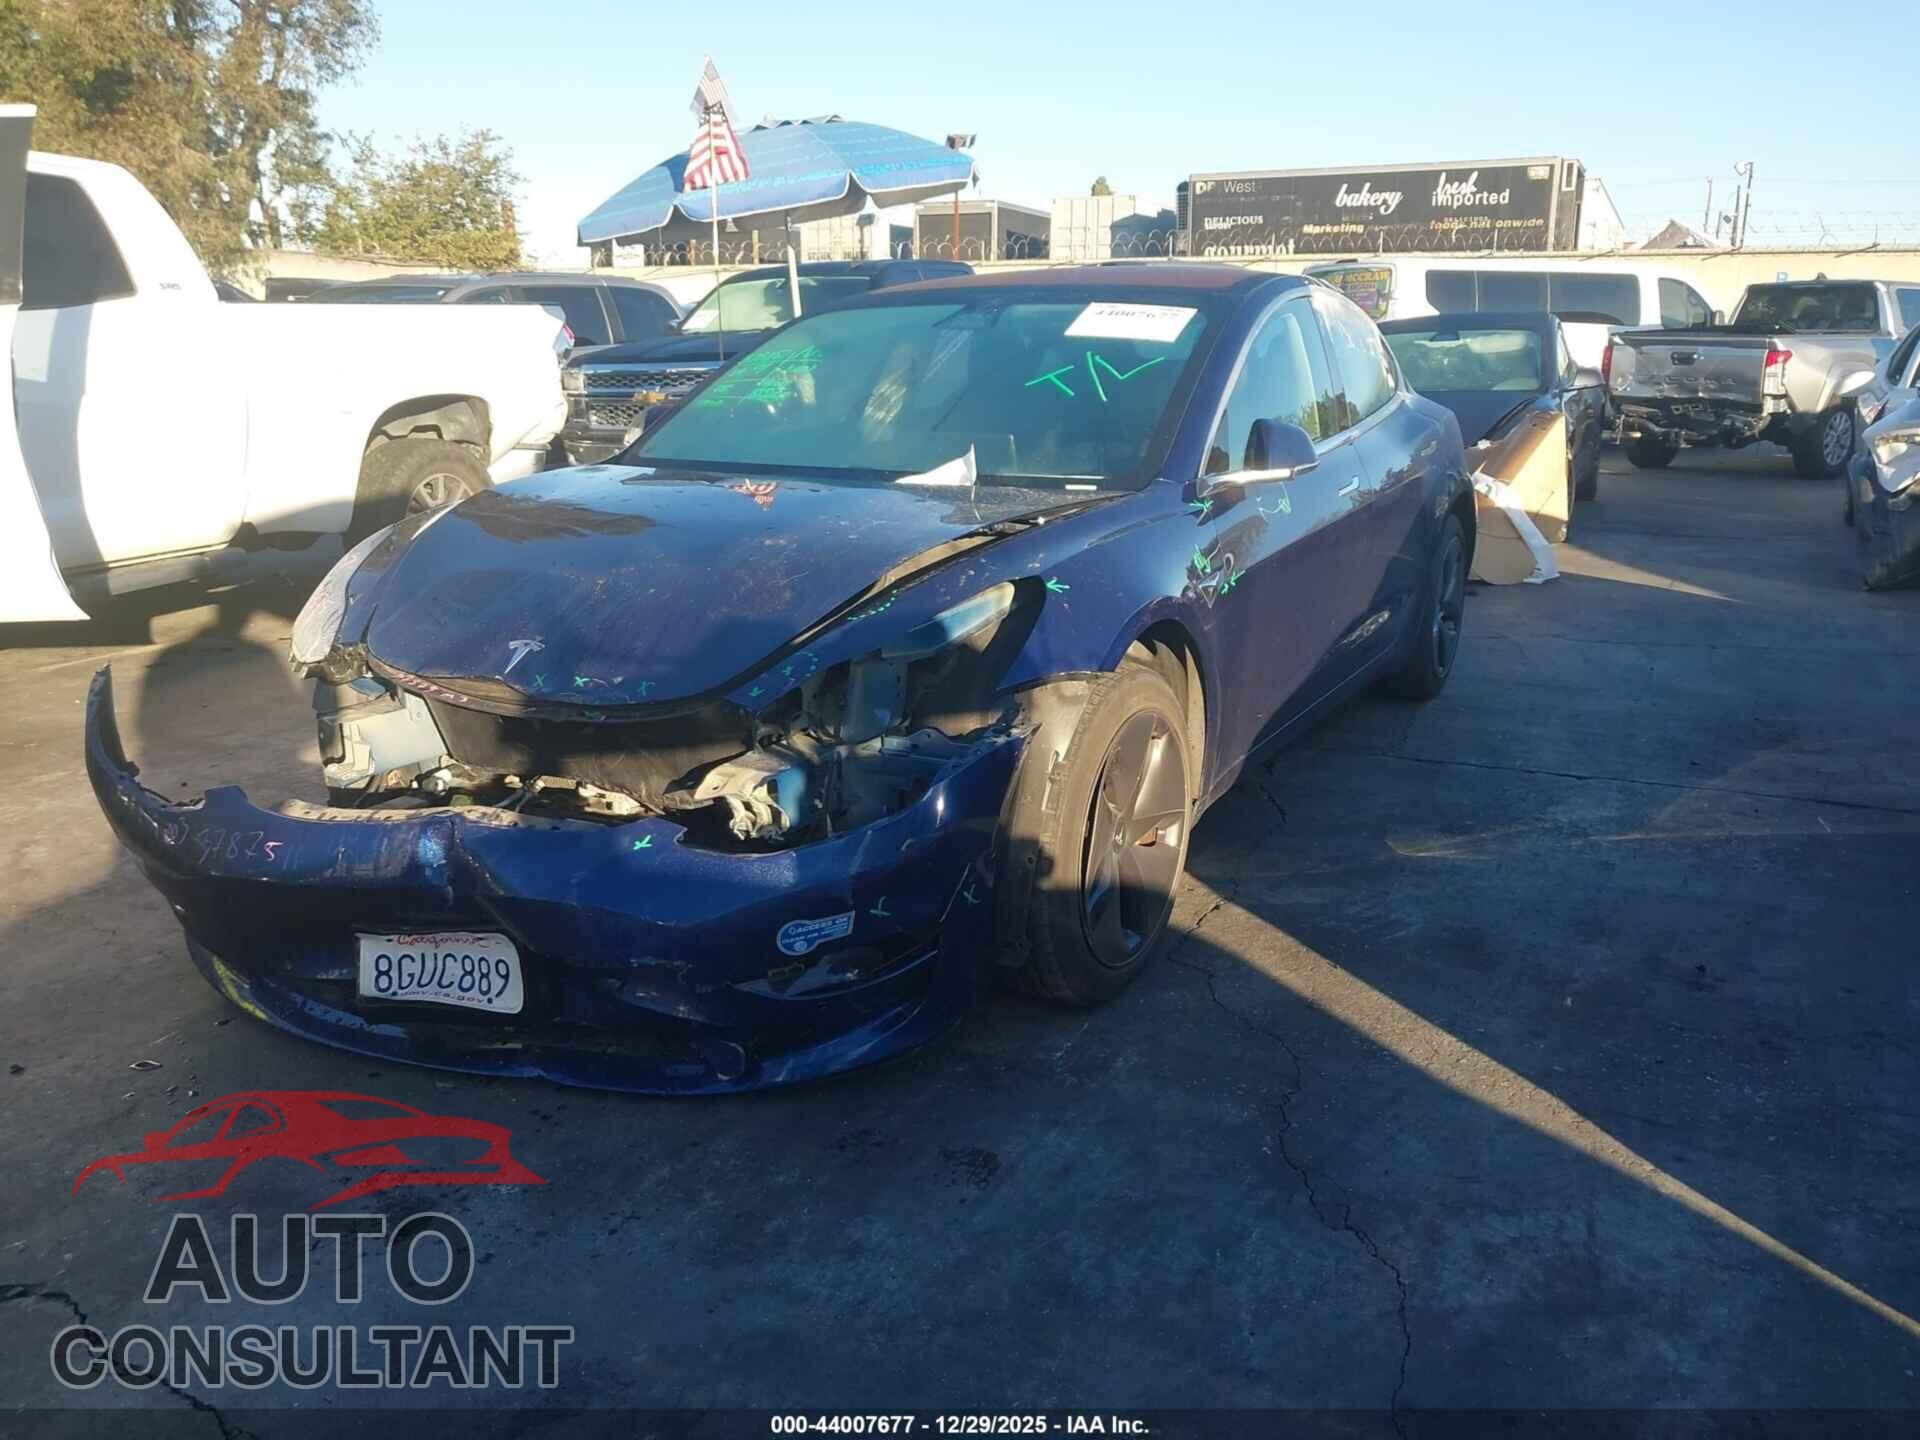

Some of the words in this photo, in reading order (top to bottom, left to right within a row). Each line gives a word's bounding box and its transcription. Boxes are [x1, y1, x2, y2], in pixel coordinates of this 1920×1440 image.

[1223, 180, 1257, 193] West
[1335, 182, 1403, 214] bakery
[1432, 188, 1509, 209] imported
[1204, 215, 1264, 227] DELICIOUS
[1302, 223, 1365, 235] Marketing
